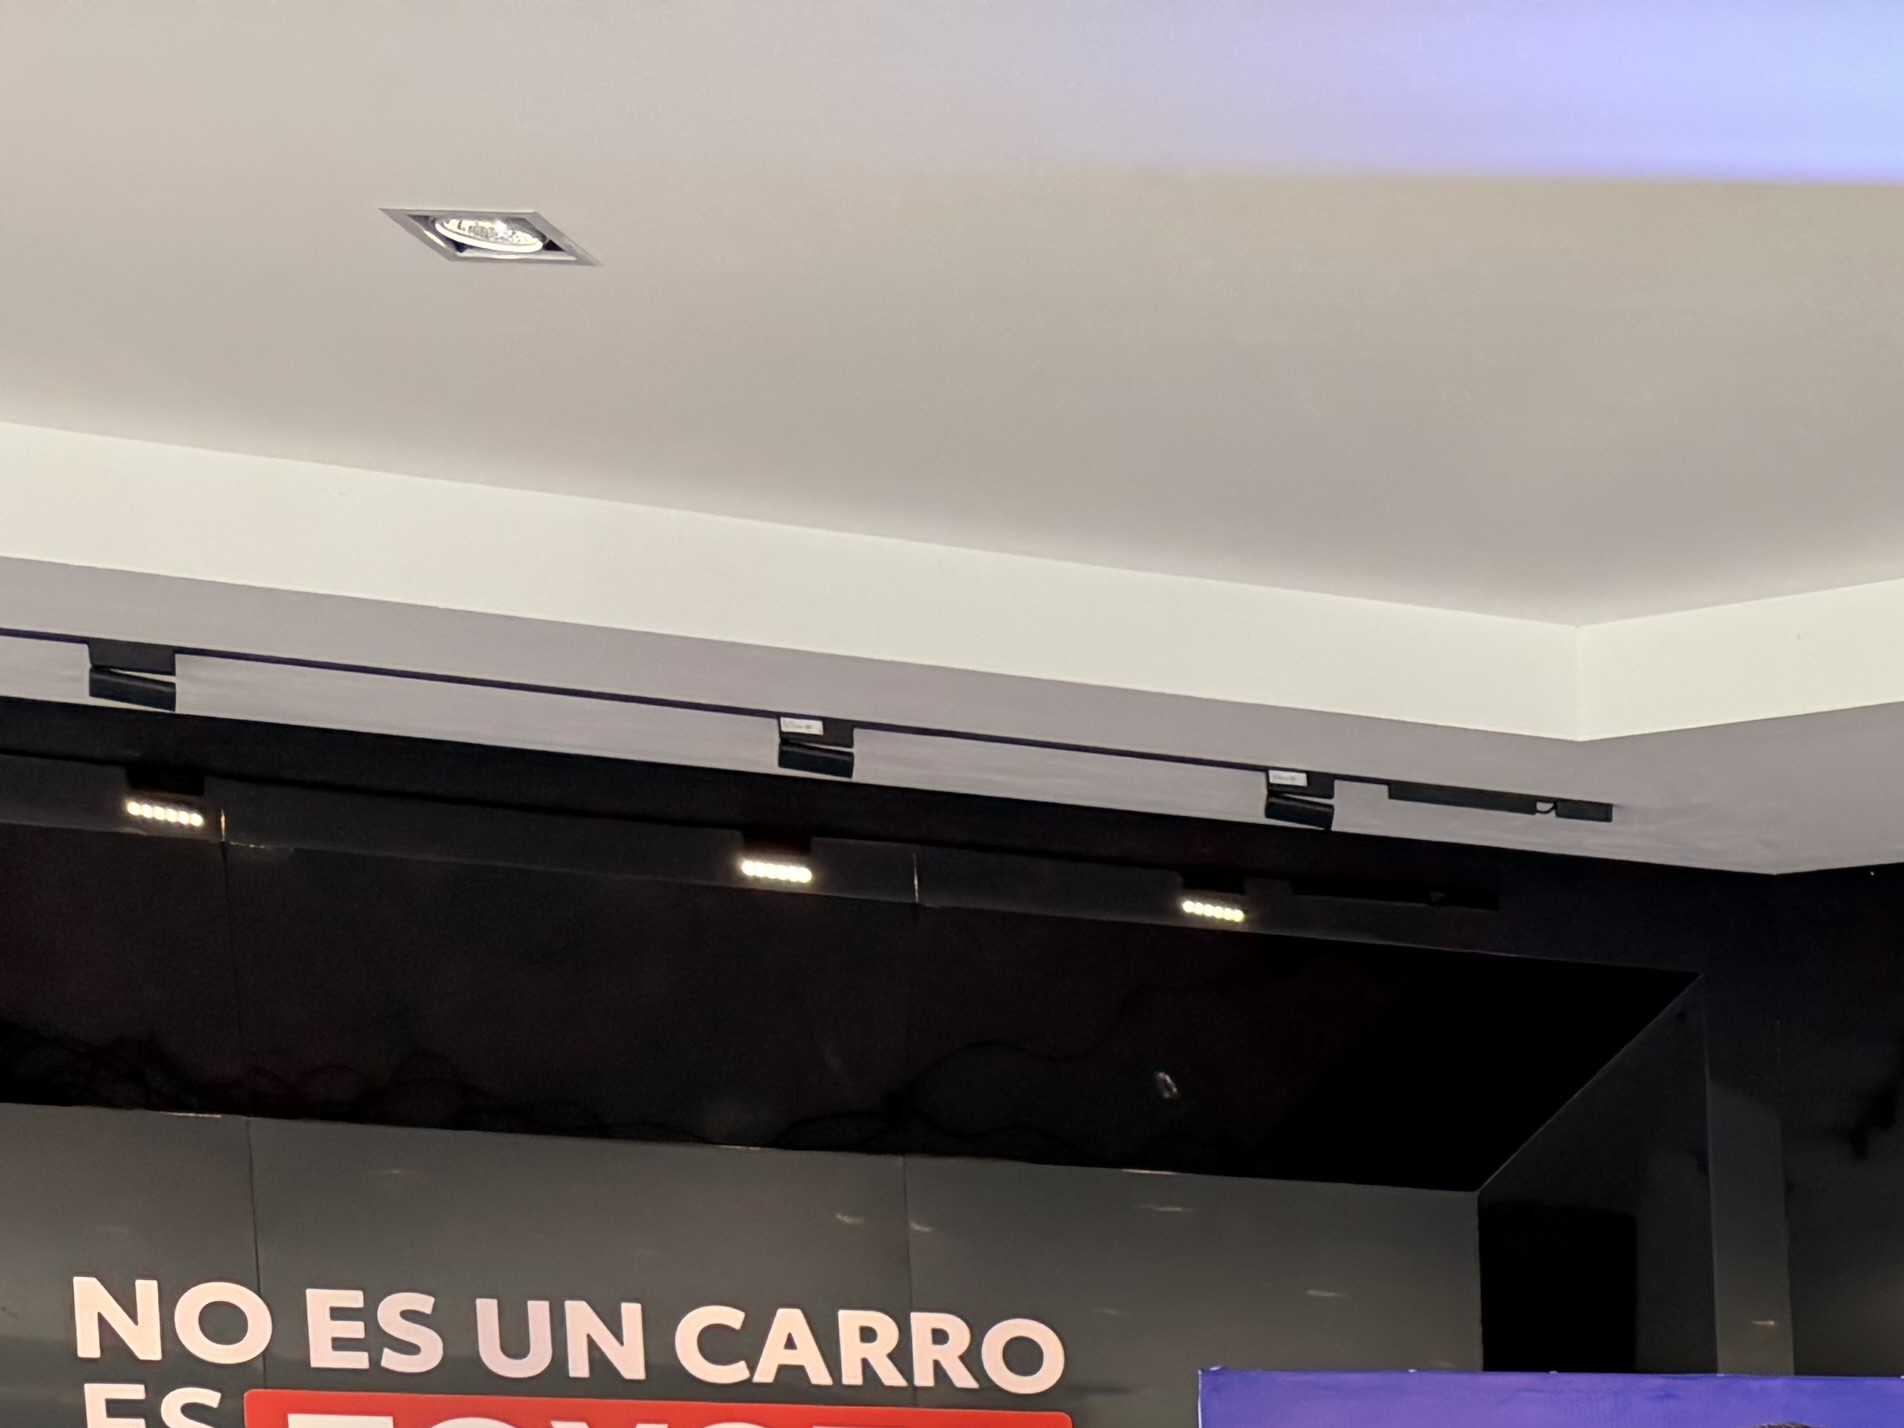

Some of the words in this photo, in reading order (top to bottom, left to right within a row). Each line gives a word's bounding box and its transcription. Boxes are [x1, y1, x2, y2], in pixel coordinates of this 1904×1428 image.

[71, 1275, 272, 1365] NO
[305, 1288, 444, 1374] ES
[475, 1299, 646, 1381] UN
[673, 1305, 1066, 1395] CARRO
